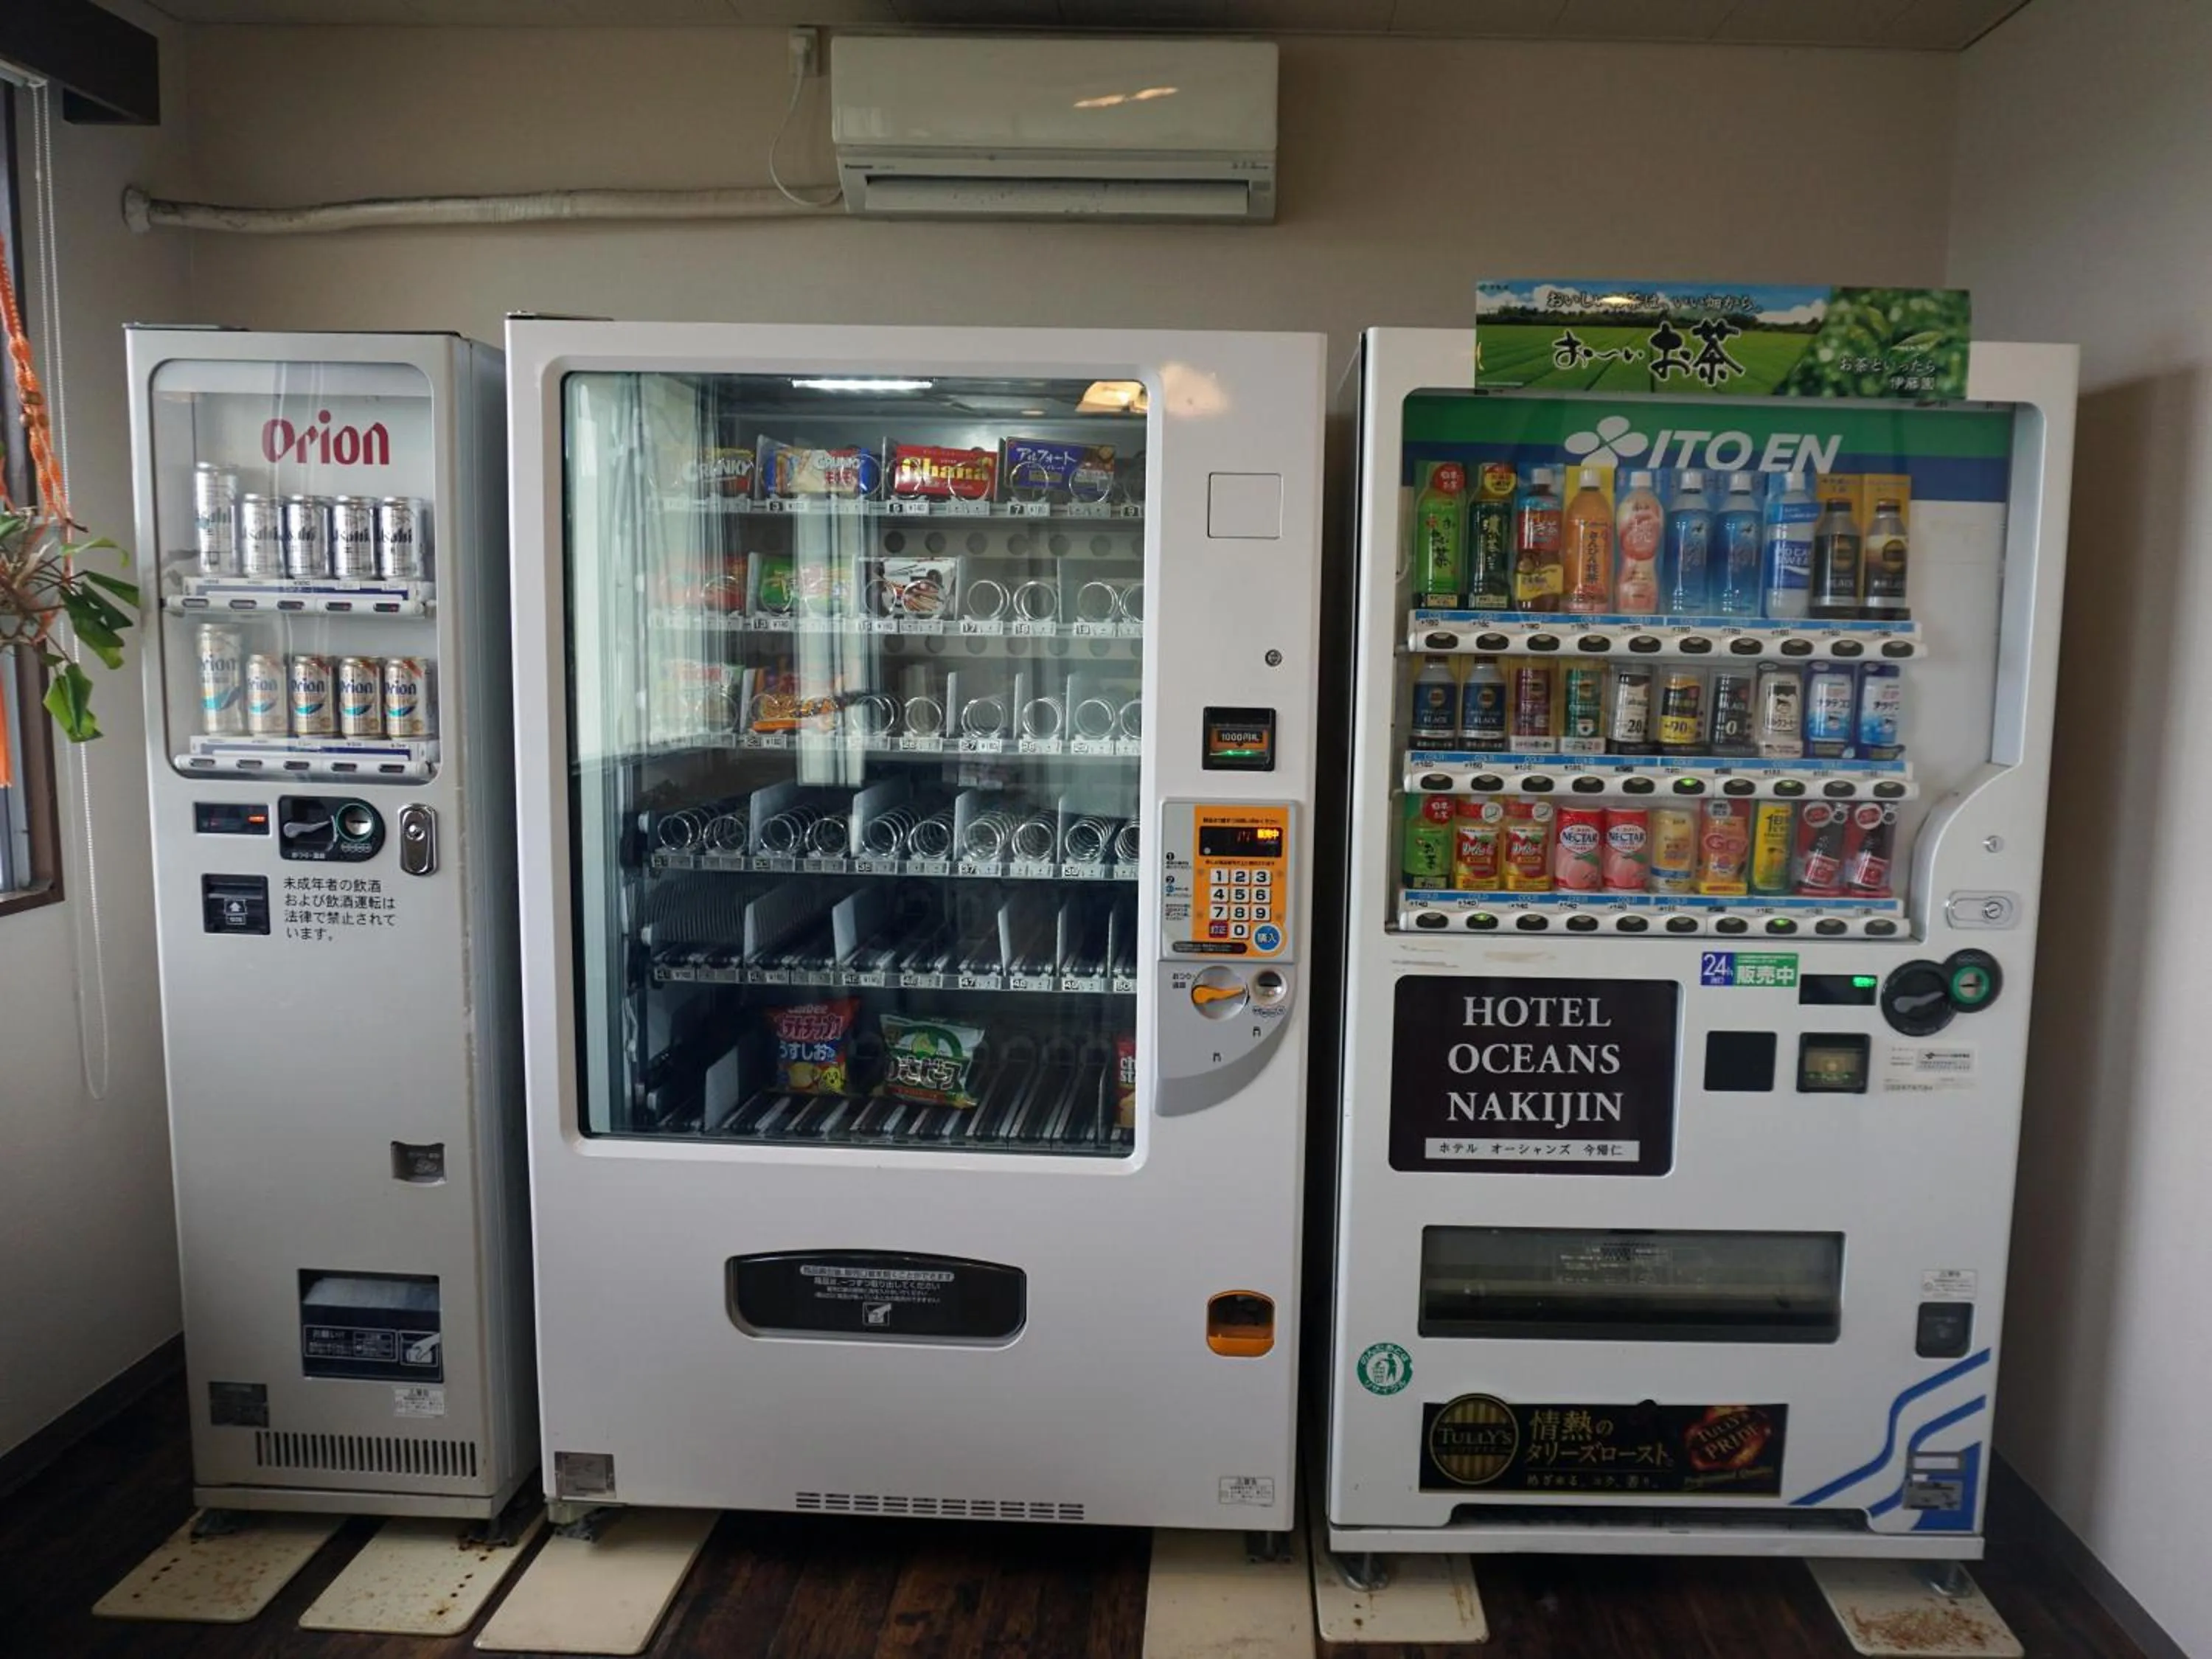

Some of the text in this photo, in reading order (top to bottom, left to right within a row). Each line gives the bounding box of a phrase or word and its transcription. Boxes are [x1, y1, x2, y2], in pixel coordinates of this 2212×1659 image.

[262, 410, 389, 465] Orion
[1645, 430, 1841, 473] ITO EN
[901, 455, 992, 480] Ghana
[283, 877, 382, 892] 未成年者の飲酒
[1216, 871, 1266, 883] 1 2 3
[285, 895, 395, 909] および飲酒運転は
[1214, 888, 1266, 901] 4 5 6
[285, 911, 396, 927] 法律で禁止されて
[1214, 907, 1266, 919] 7 8 9
[287, 928, 334, 942] います。
[1234, 925, 1245, 936] 0
[1703, 953, 1733, 977] 24h
[1736, 964, 1795, 985] 販売中
[1462, 996, 1612, 1026] HOTEL
[1447, 1043, 1621, 1074] OCEANS
[1446, 1091, 1624, 1129] NAKIJIN
[1439, 1143, 1623, 1156] ホテル オーシャンズ 今帰仁
[1528, 1409, 1614, 1441] 情熱の
